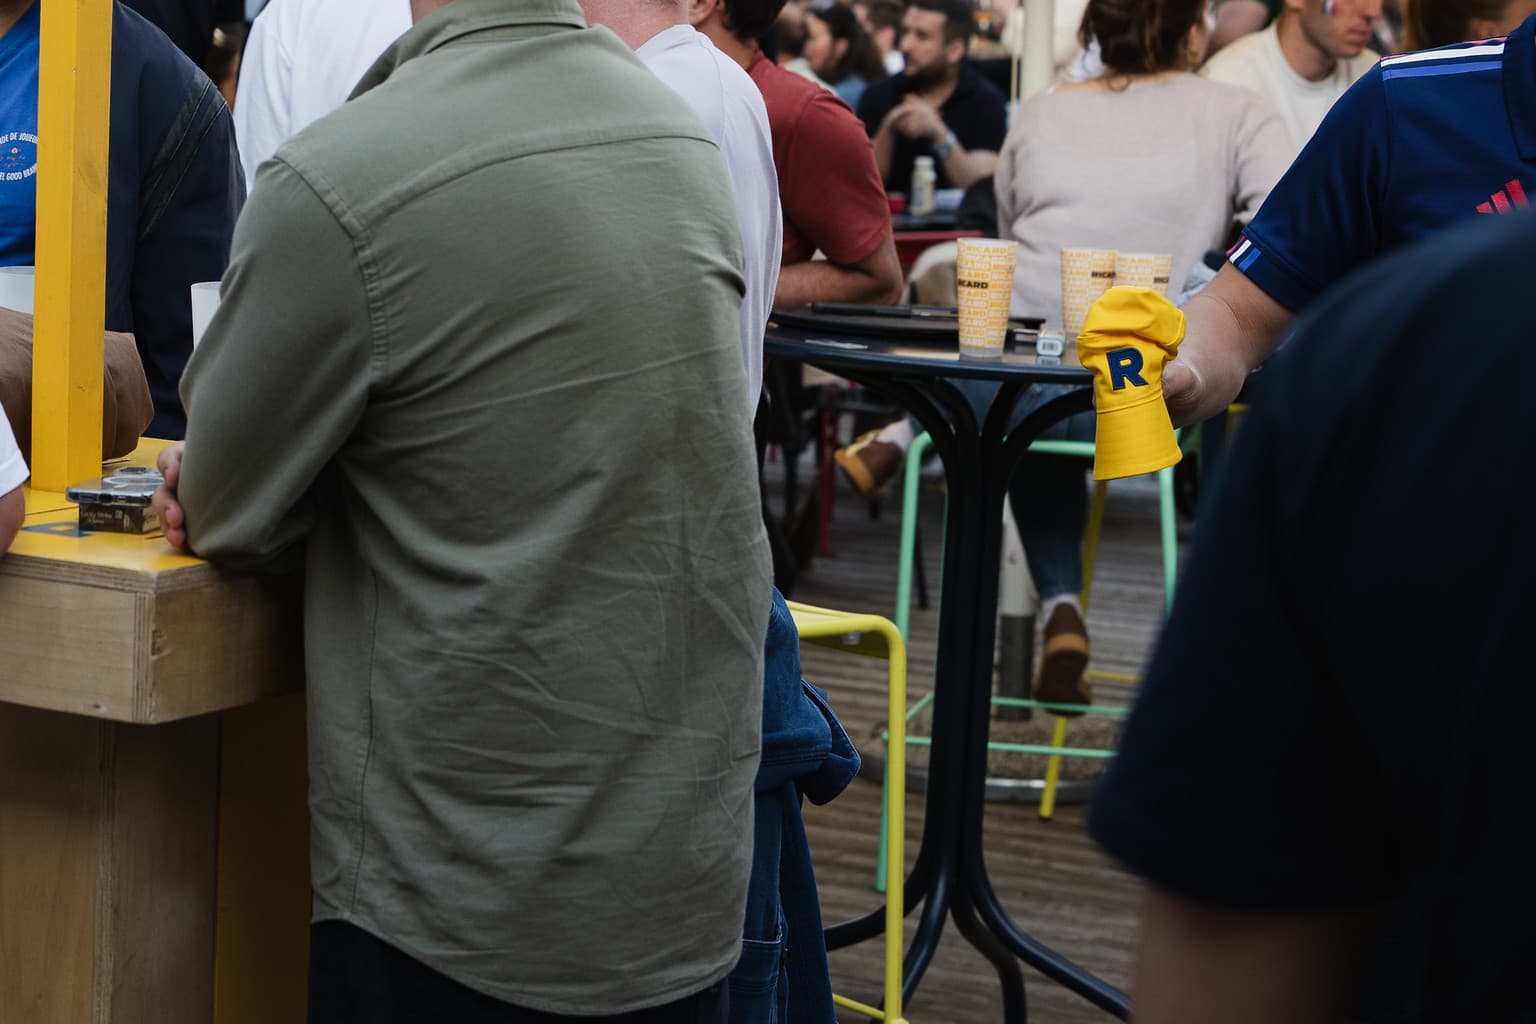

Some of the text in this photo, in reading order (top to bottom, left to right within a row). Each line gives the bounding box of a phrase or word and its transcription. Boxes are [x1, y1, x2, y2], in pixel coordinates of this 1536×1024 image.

[10, 132, 17, 140] DE
[6, 172, 22, 181] GOOD
[1106, 347, 1148, 391] R
